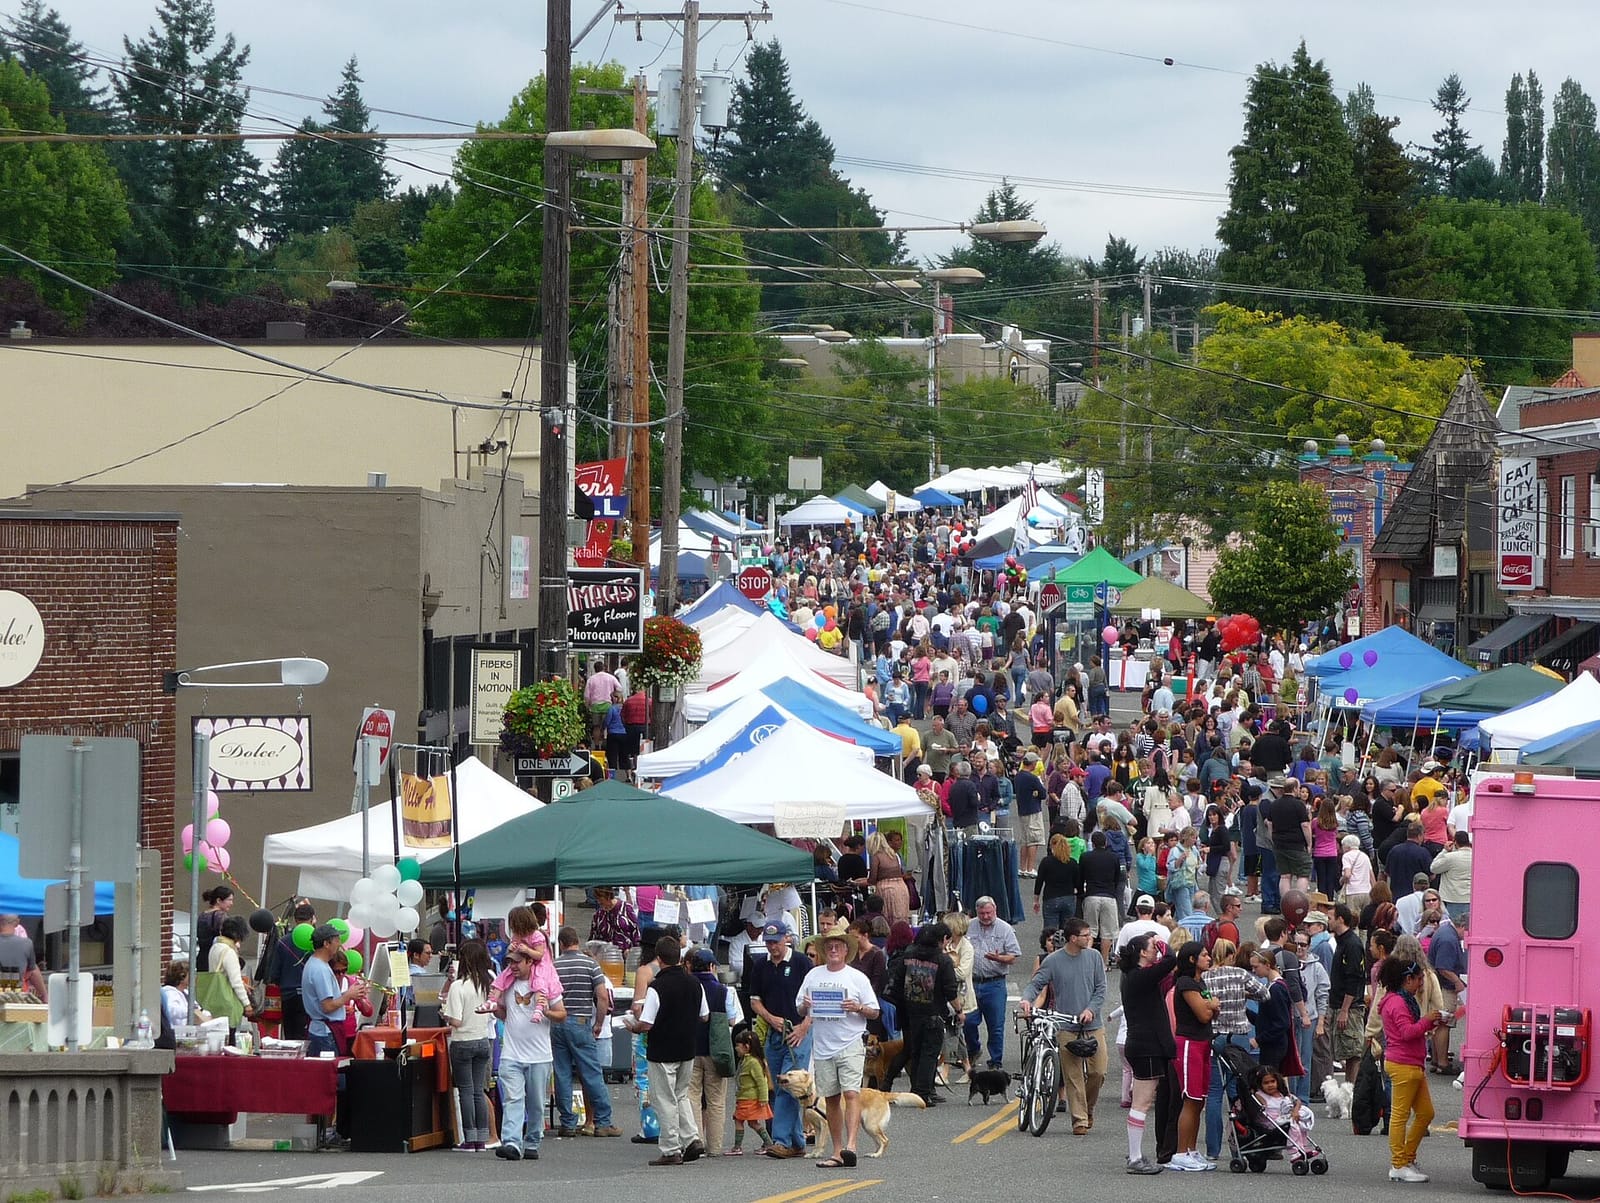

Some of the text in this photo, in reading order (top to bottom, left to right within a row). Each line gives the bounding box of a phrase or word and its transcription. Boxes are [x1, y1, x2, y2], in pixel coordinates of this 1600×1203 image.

[1506, 462, 1531, 485] FAT
[578, 474, 615, 497] er's
[1504, 477, 1533, 501] CITY
[1091, 470, 1102, 522] ANTIQUES
[1503, 494, 1533, 523] CAFE
[1331, 513, 1353, 522] TOYS
[1501, 520, 1534, 541] BREAKFAST
[1501, 541, 1533, 553] LUNCH
[740, 576, 769, 590] STOP
[567, 577, 636, 612] IMAGES
[1041, 593, 1059, 608] STOP
[583, 612, 601, 628] By
[604, 608, 637, 624] Floom
[480, 660, 513, 669] FIBERS
[490, 671, 500, 680] IN
[478, 683, 512, 693] MOTION
[365, 720, 389, 733] DO NOT
[218, 741, 286, 758] Dolce!
[521, 757, 571, 769] ONE WAY
